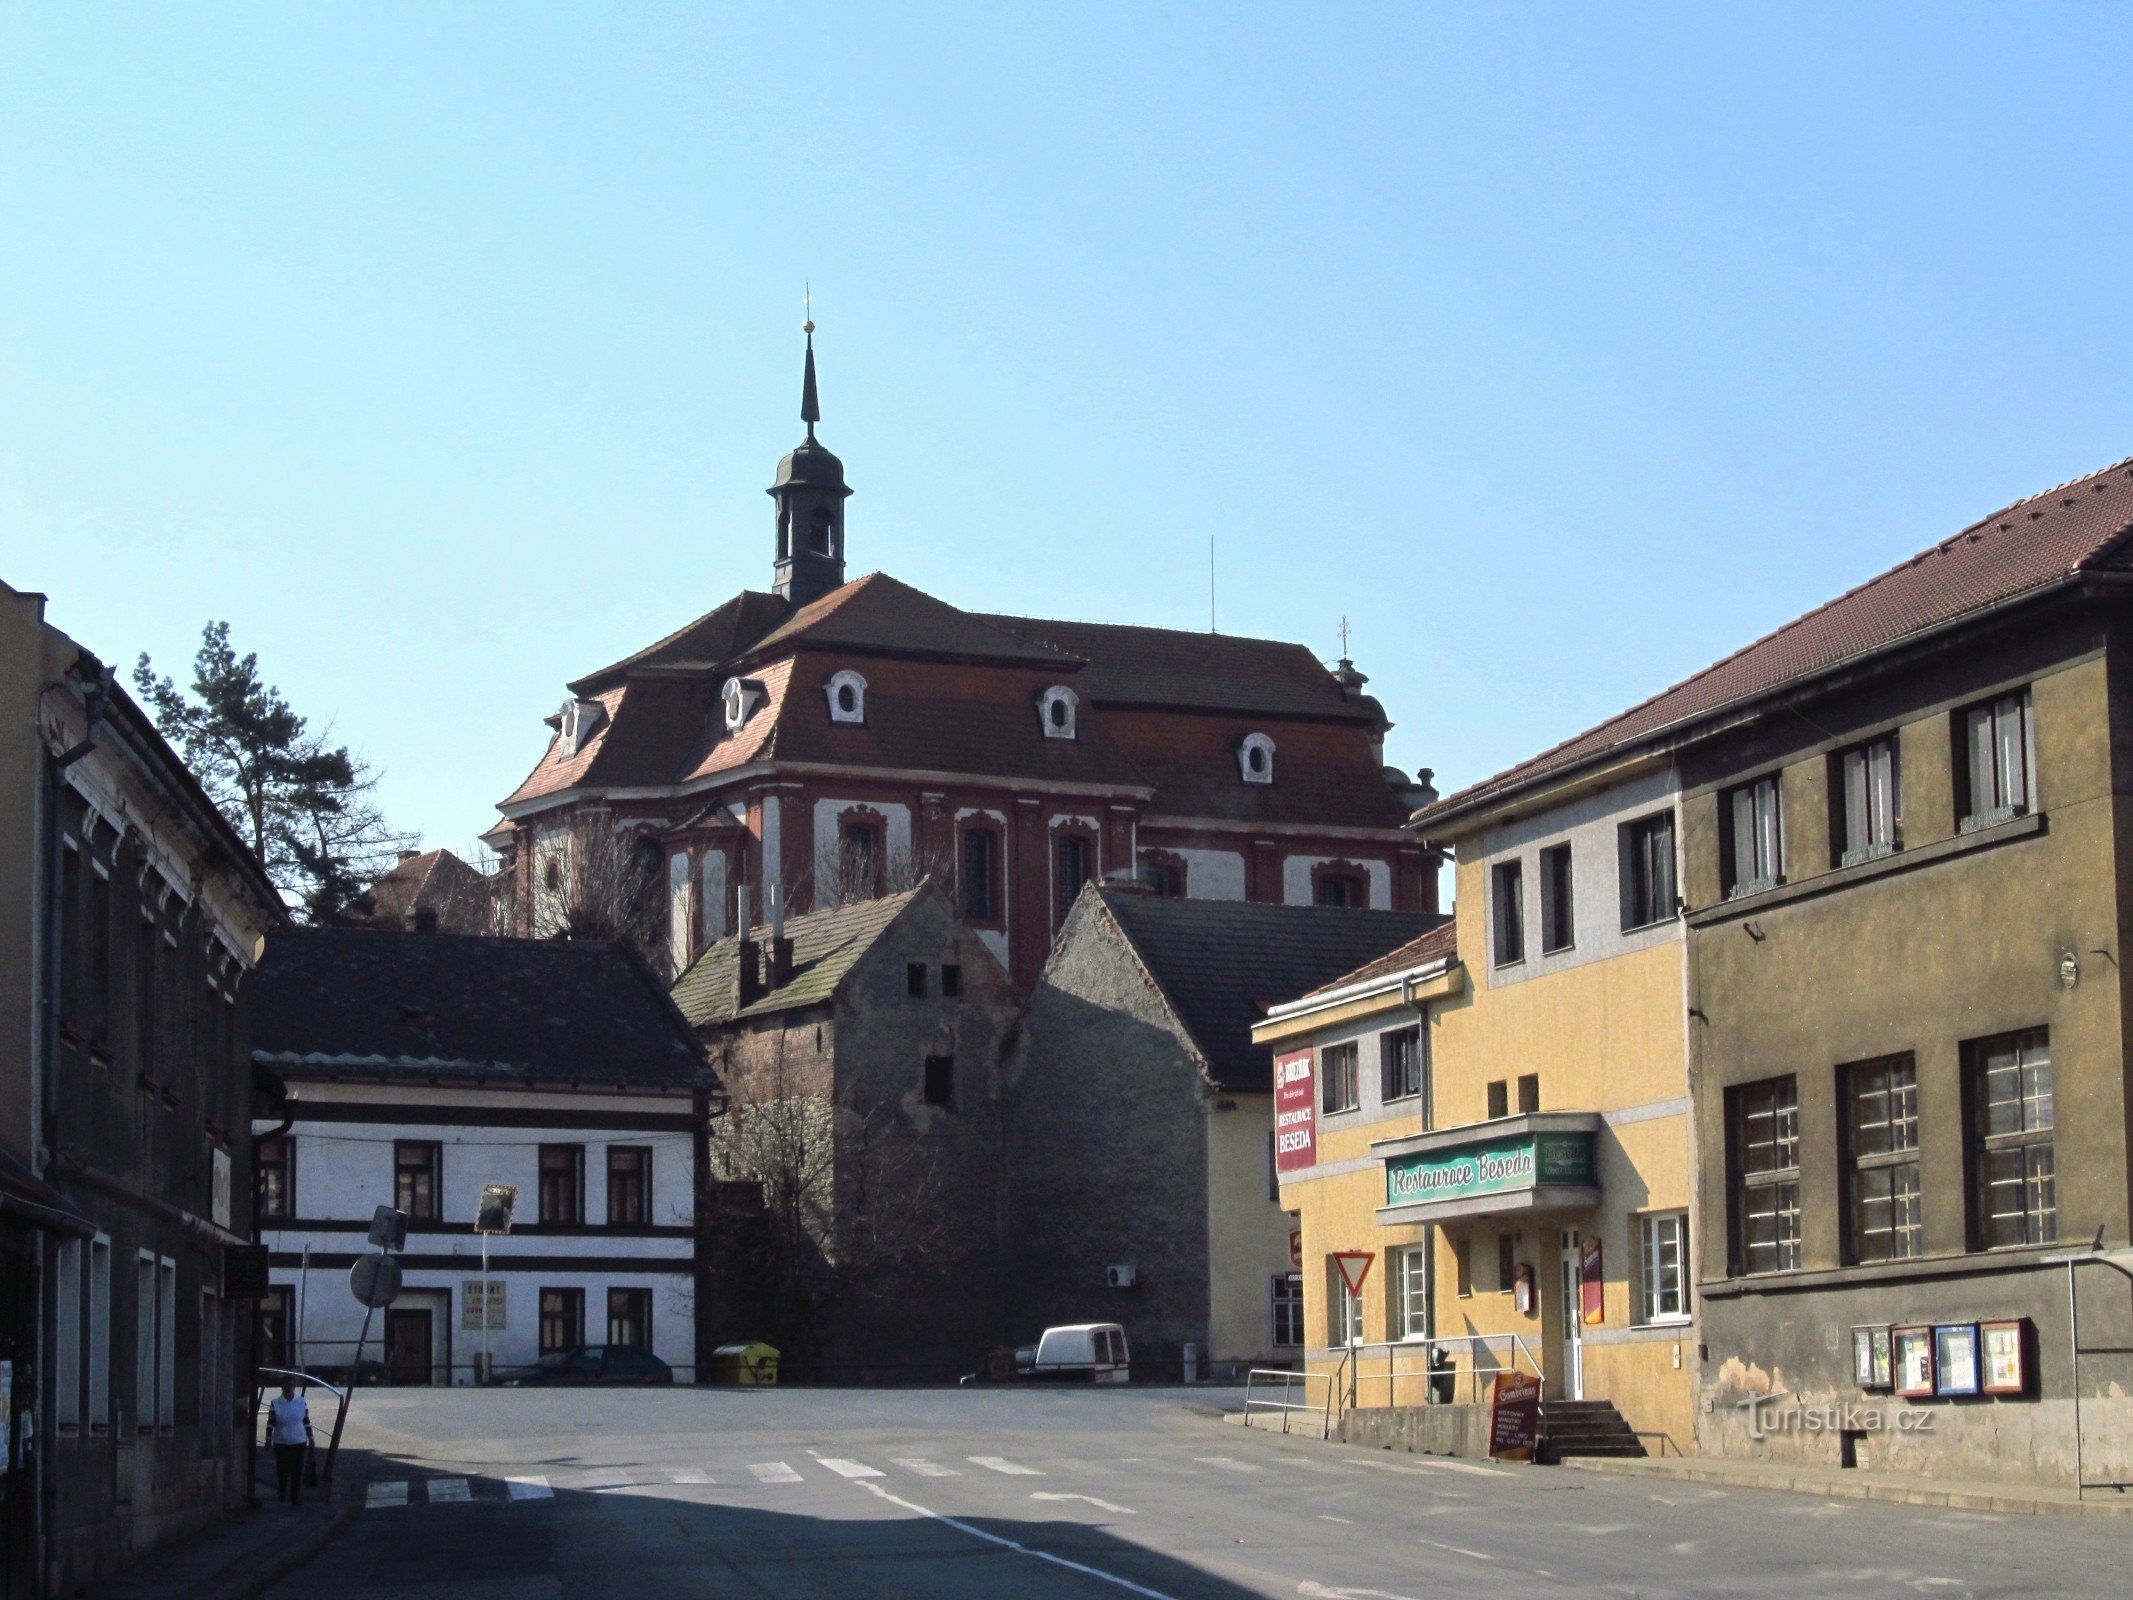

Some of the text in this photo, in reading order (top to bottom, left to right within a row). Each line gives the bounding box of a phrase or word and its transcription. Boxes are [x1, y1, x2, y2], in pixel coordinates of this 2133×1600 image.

[1279, 1108, 1312, 1127] RESTAURACE
[1279, 1129, 1312, 1154] BESEDA
[1391, 1145, 1534, 1196] Restaurace Beseda
[1499, 1386, 1536, 1401] Gambrinus
